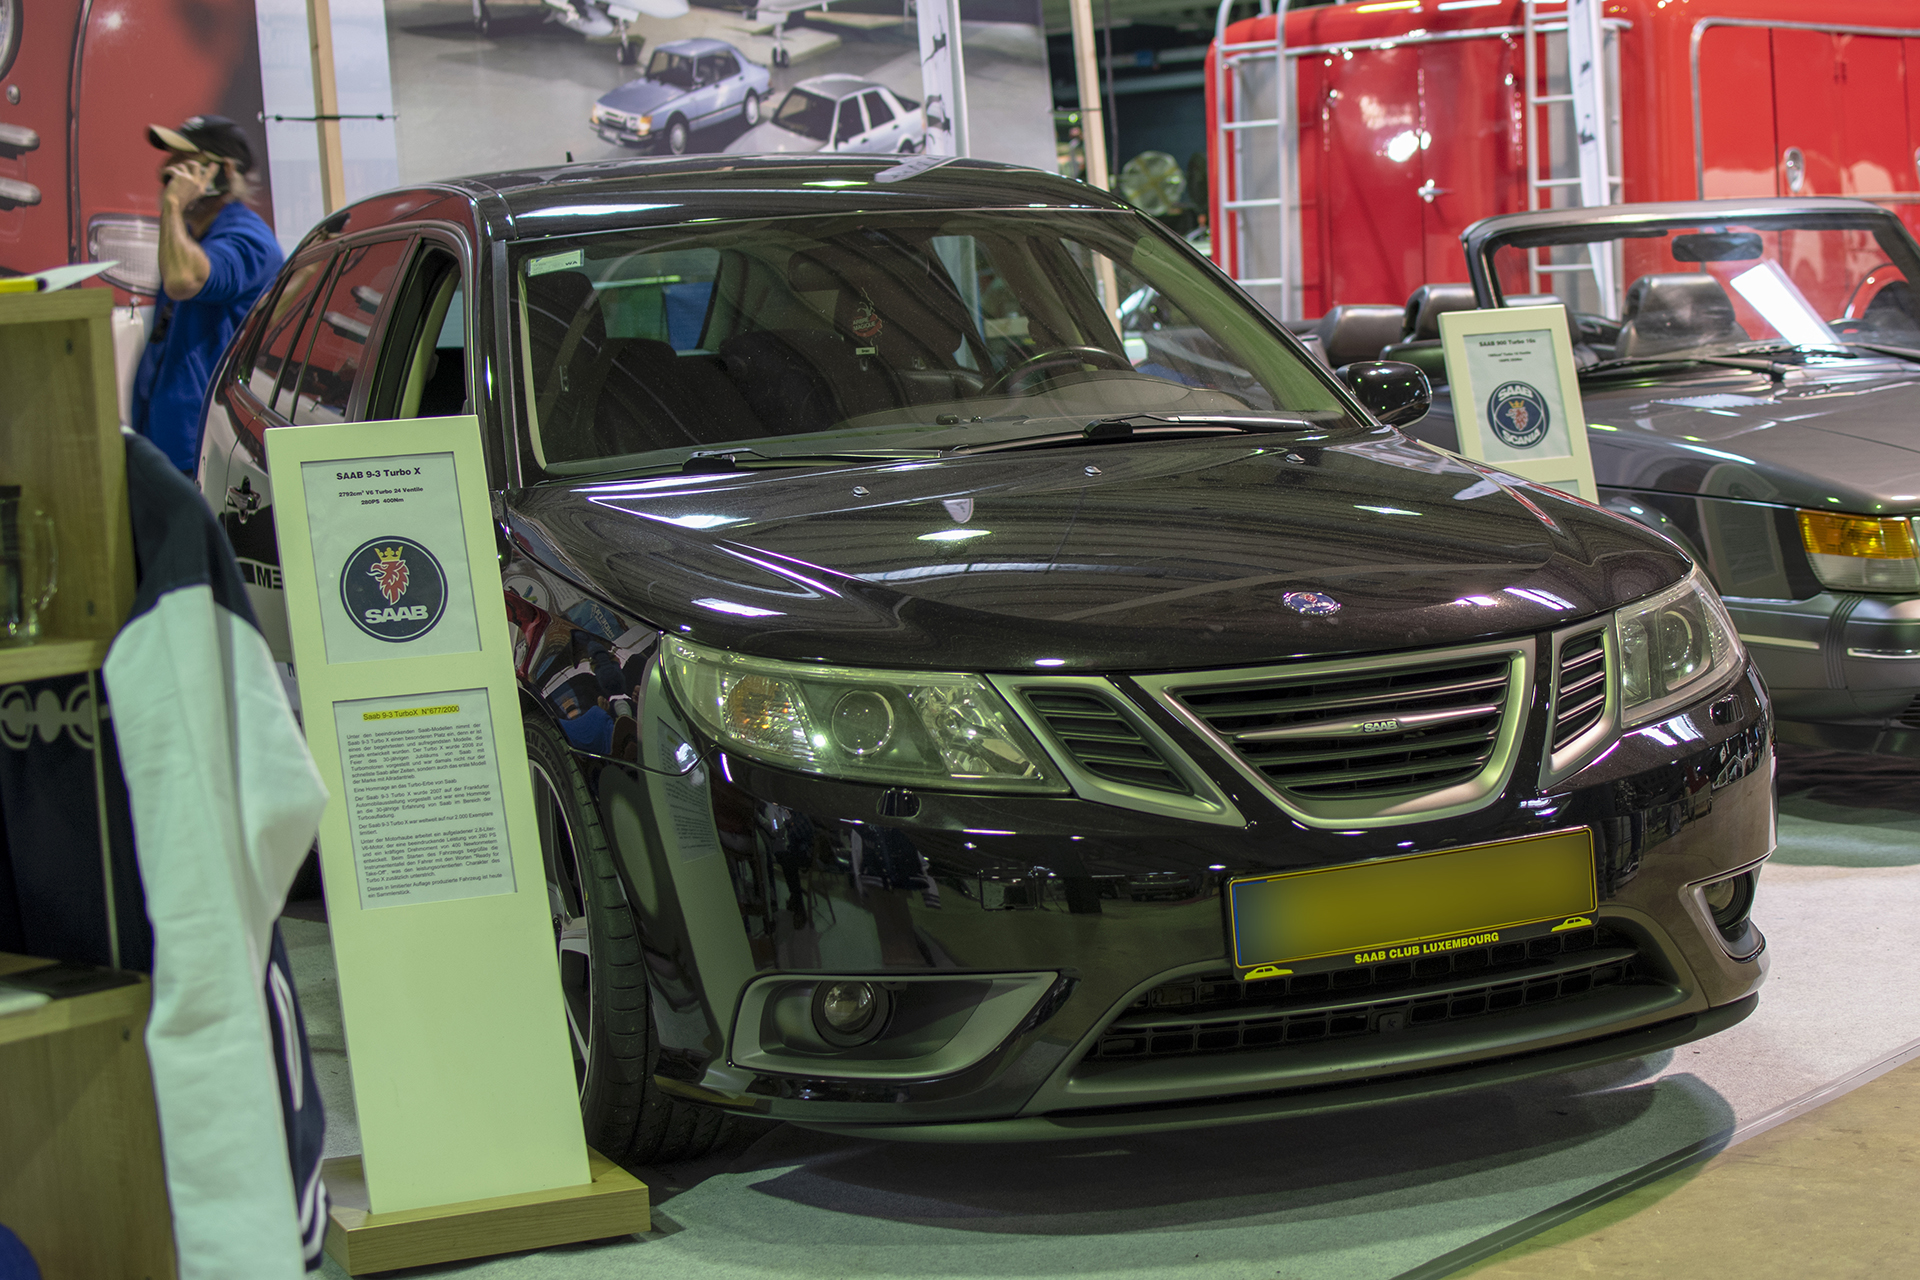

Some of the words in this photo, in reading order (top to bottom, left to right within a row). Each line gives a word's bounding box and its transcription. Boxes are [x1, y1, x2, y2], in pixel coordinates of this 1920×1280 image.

[1498, 385, 1534, 401] SAAB
[1501, 428, 1541, 445] SCANIA
[336, 471, 364, 480] SAAB
[366, 470, 381, 478] 9-3
[383, 468, 412, 477] Turbo
[414, 467, 421, 475] X
[365, 605, 429, 624] SAAB
[363, 713, 380, 721] Saab
[394, 709, 418, 718] TurboX
[1364, 720, 1399, 732] SAAB
[1354, 950, 1386, 964] SAAB
[1388, 945, 1420, 959] CLUB
[1422, 932, 1499, 954] LUXEMBOURG
